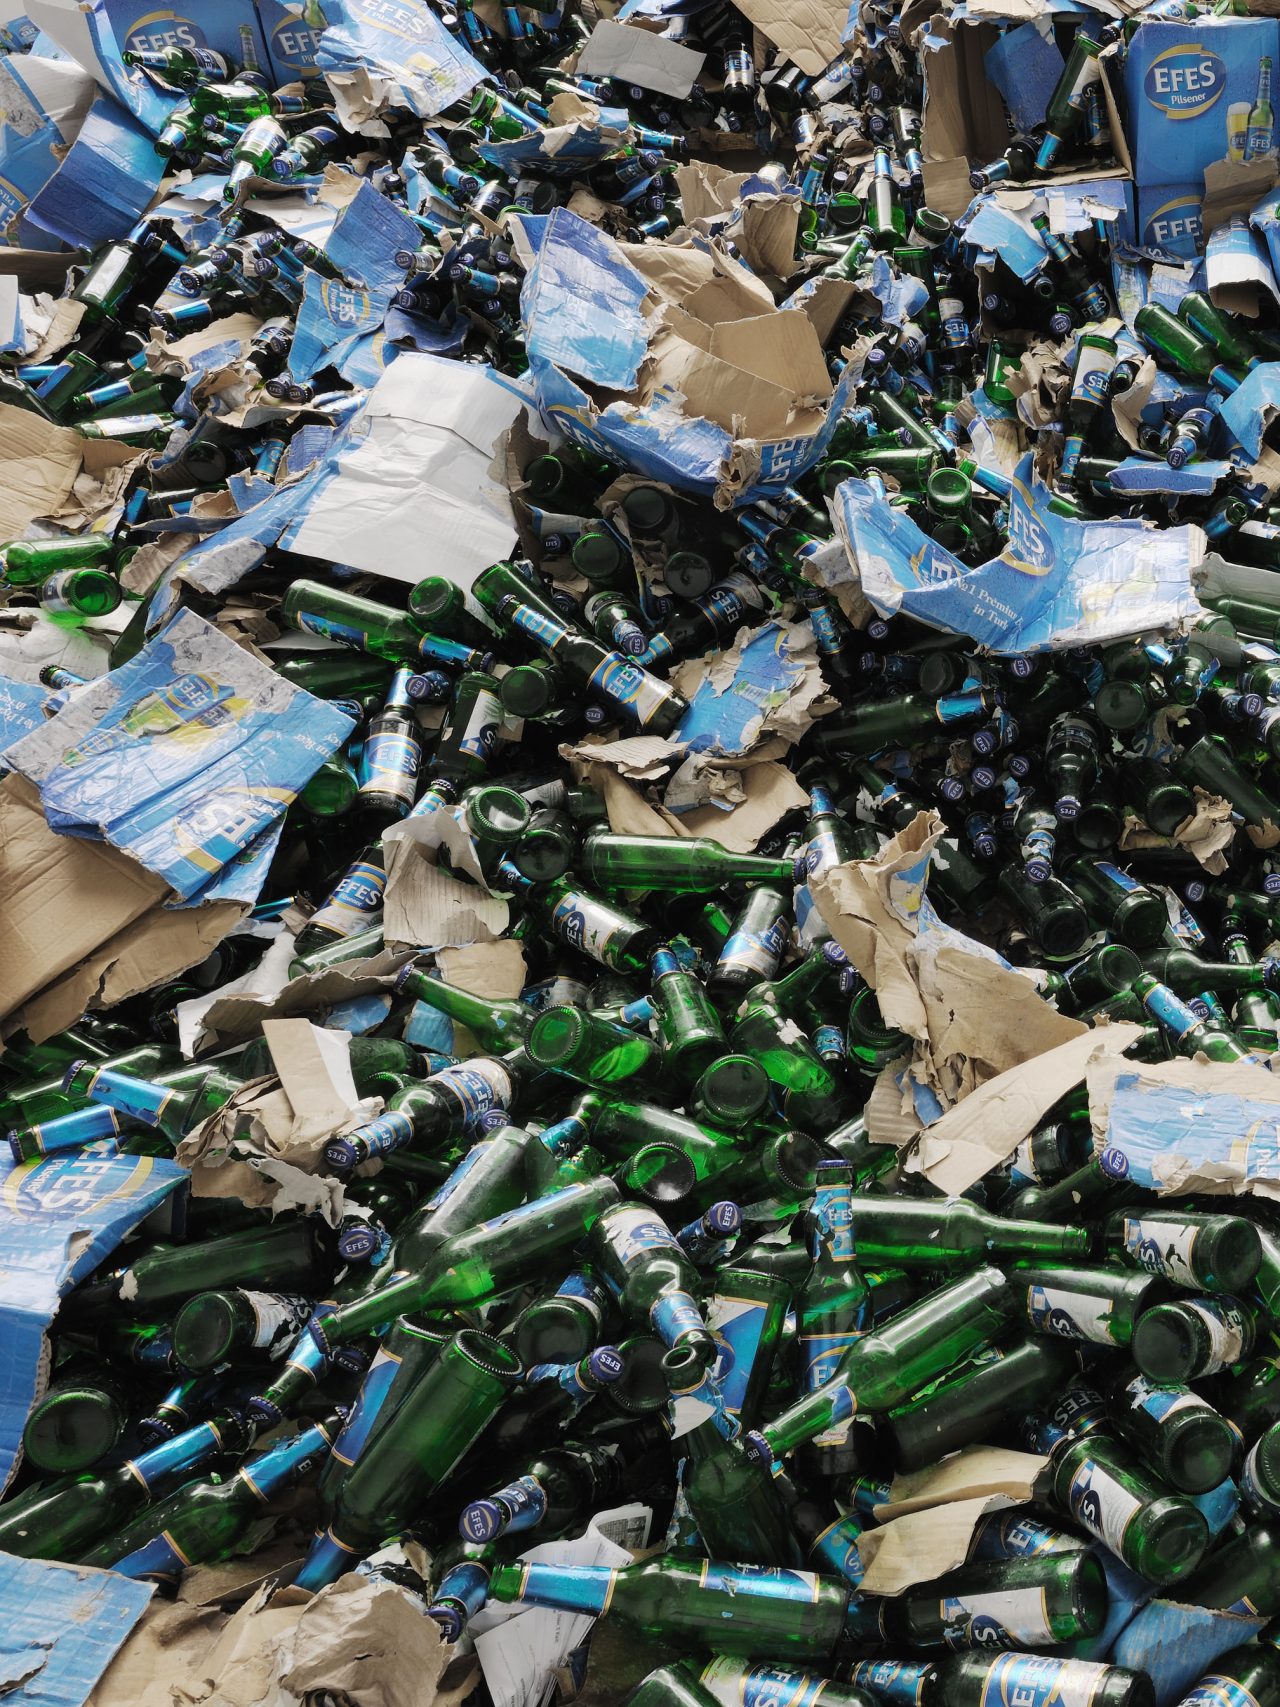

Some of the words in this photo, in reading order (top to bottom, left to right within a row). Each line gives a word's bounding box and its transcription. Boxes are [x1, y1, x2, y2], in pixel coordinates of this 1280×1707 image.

[279, 30, 323, 53] EFE
[1155, 60, 1216, 94] EFES
[1172, 92, 1206, 105] Pilsener
[1250, 136, 1271, 149] EFES
[1154, 214, 1202, 243] EFE
[764, 440, 793, 484] EFE
[711, 591, 739, 624] EFES
[978, 589, 1016, 619] Premiu
[973, 605, 985, 616] in
[987, 612, 1008, 631] Turk
[871, 625, 884, 635] EFES
[1016, 659, 1025, 675] EFES
[608, 664, 640, 699] EFES
[976, 738, 986, 752] EFES
[975, 772, 990, 785] EFES
[1059, 808, 1075, 816] EFES
[1030, 866, 1046, 879] EFES
[336, 879, 380, 905] EFES
[1194, 1006, 1207, 1016] EFES
[463, 1067, 489, 1115] EFES
[487, 1117, 507, 1127] EFES
[326, 1149, 347, 1161] EFES
[1112, 1151, 1122, 1169] EFES
[722, 1205, 733, 1226] EFES
[828, 1208, 852, 1220] EFES
[346, 1239, 369, 1252] EFES
[338, 1357, 359, 1371] EFES
[599, 1354, 621, 1371] EFES
[471, 1511, 484, 1536] EFES
